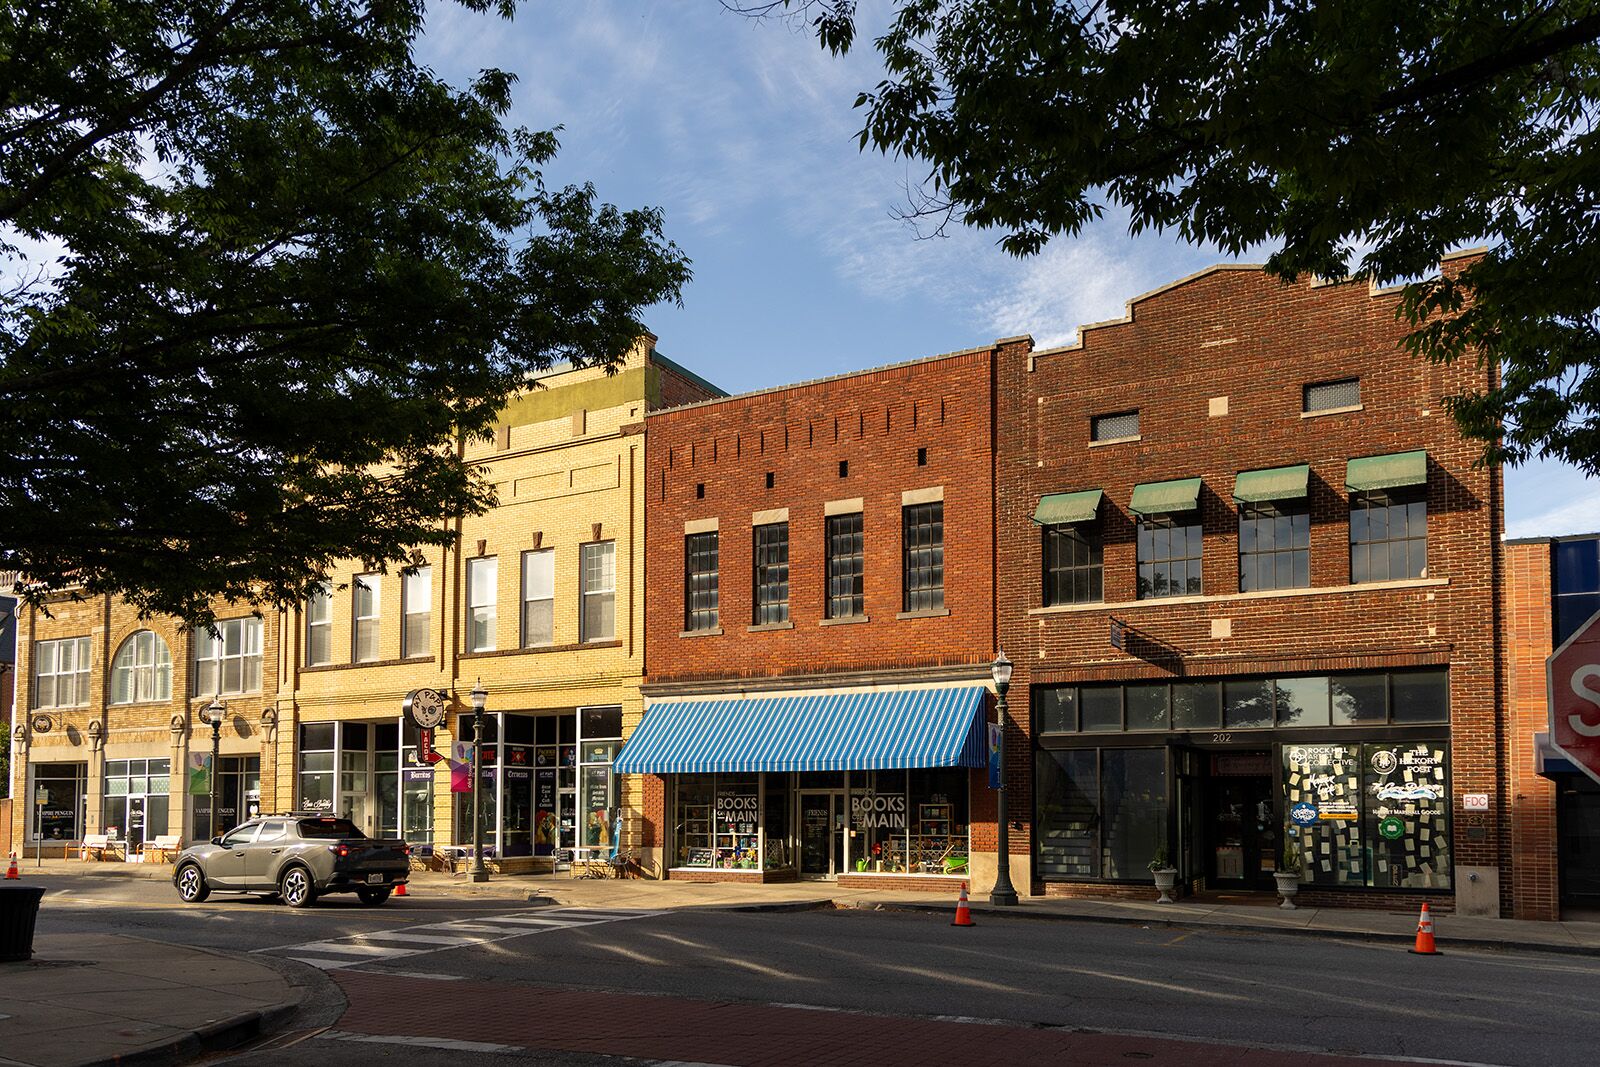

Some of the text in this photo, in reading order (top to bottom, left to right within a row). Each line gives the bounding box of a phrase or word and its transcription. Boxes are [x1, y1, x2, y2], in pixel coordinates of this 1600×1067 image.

[1213, 733, 1232, 742] 202
[717, 797, 757, 810] BOOKS
[851, 797, 905, 811] BOOKS
[1464, 796, 1487, 807] FDC
[725, 810, 757, 822] MAIN
[863, 813, 905, 828] MAIN
